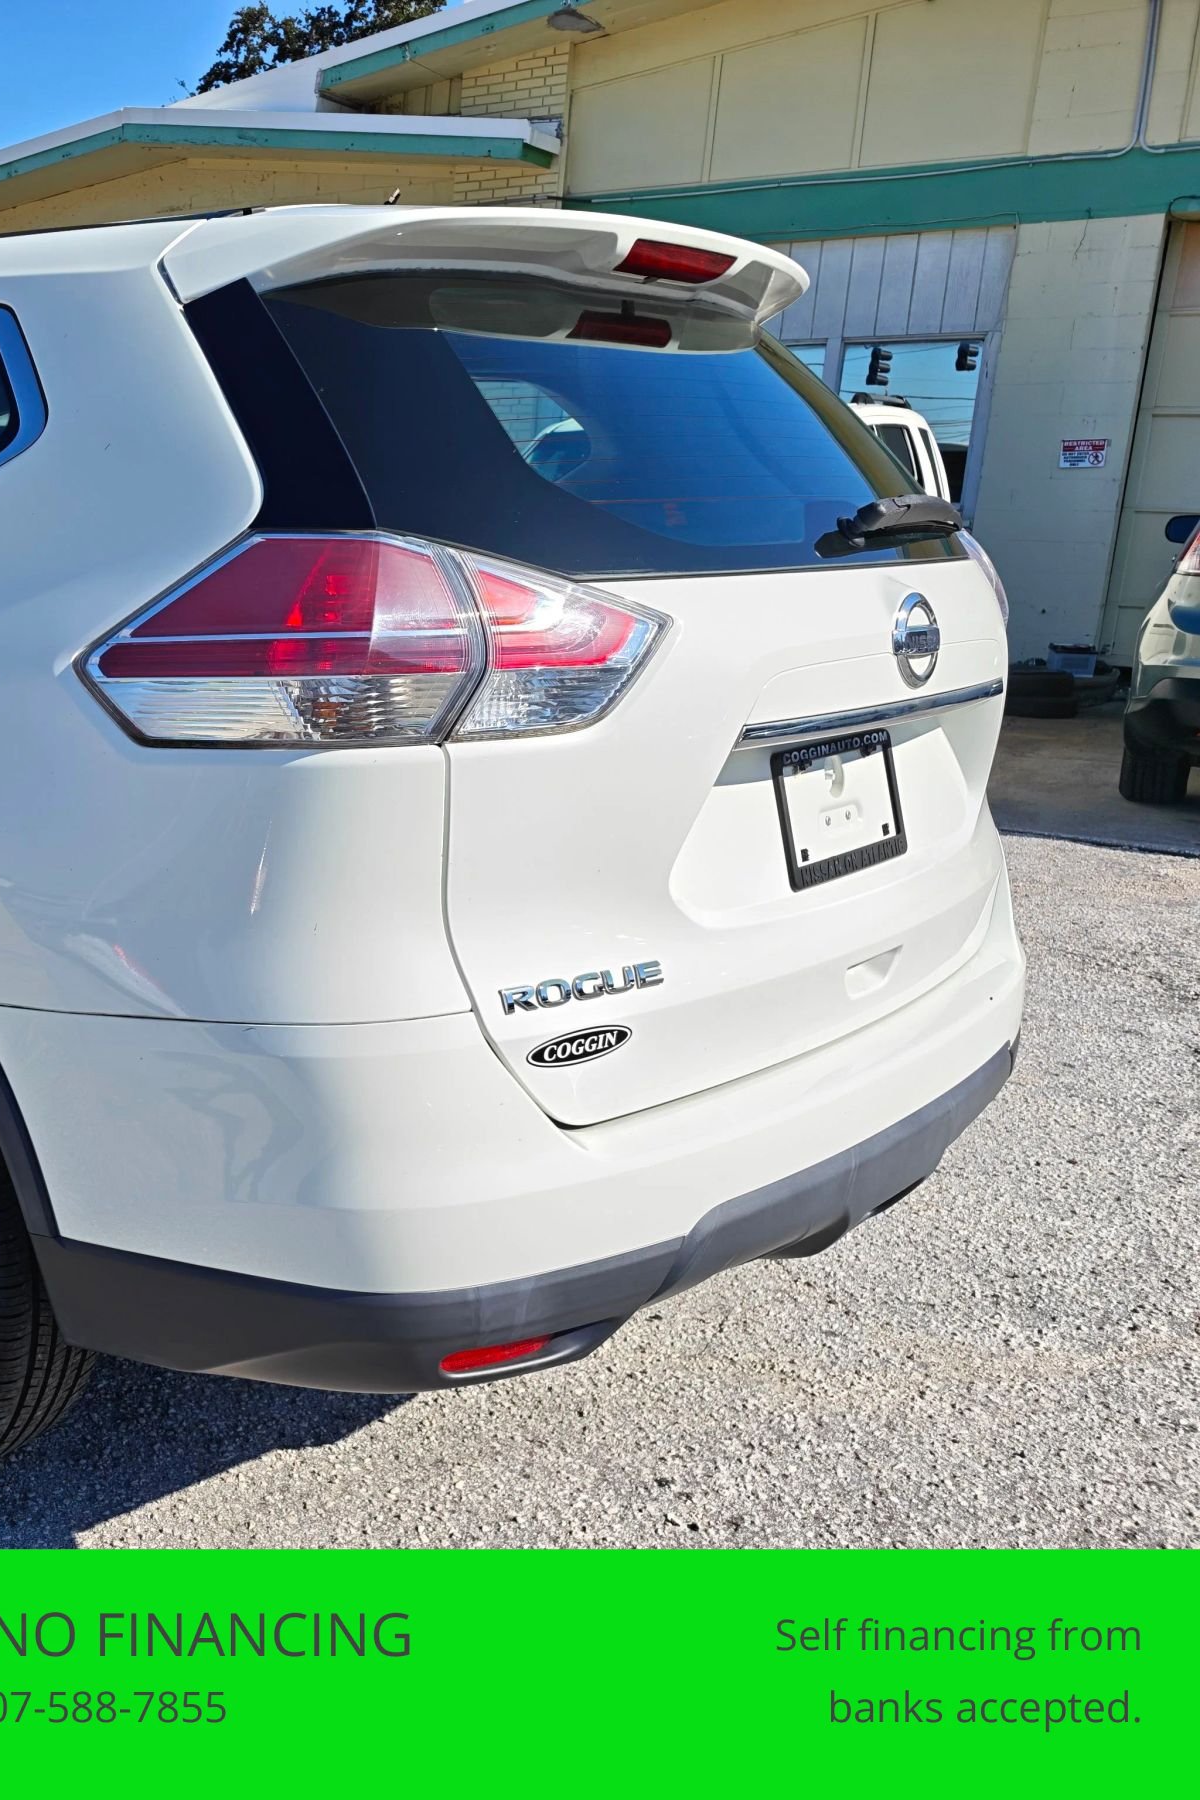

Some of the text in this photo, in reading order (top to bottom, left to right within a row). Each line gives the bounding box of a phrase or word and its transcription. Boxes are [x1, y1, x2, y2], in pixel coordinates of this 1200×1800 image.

[783, 731, 889, 764] COGGINAUTO.COM
[498, 960, 665, 1016] ROGUE
[543, 1030, 618, 1062] COGGIN
